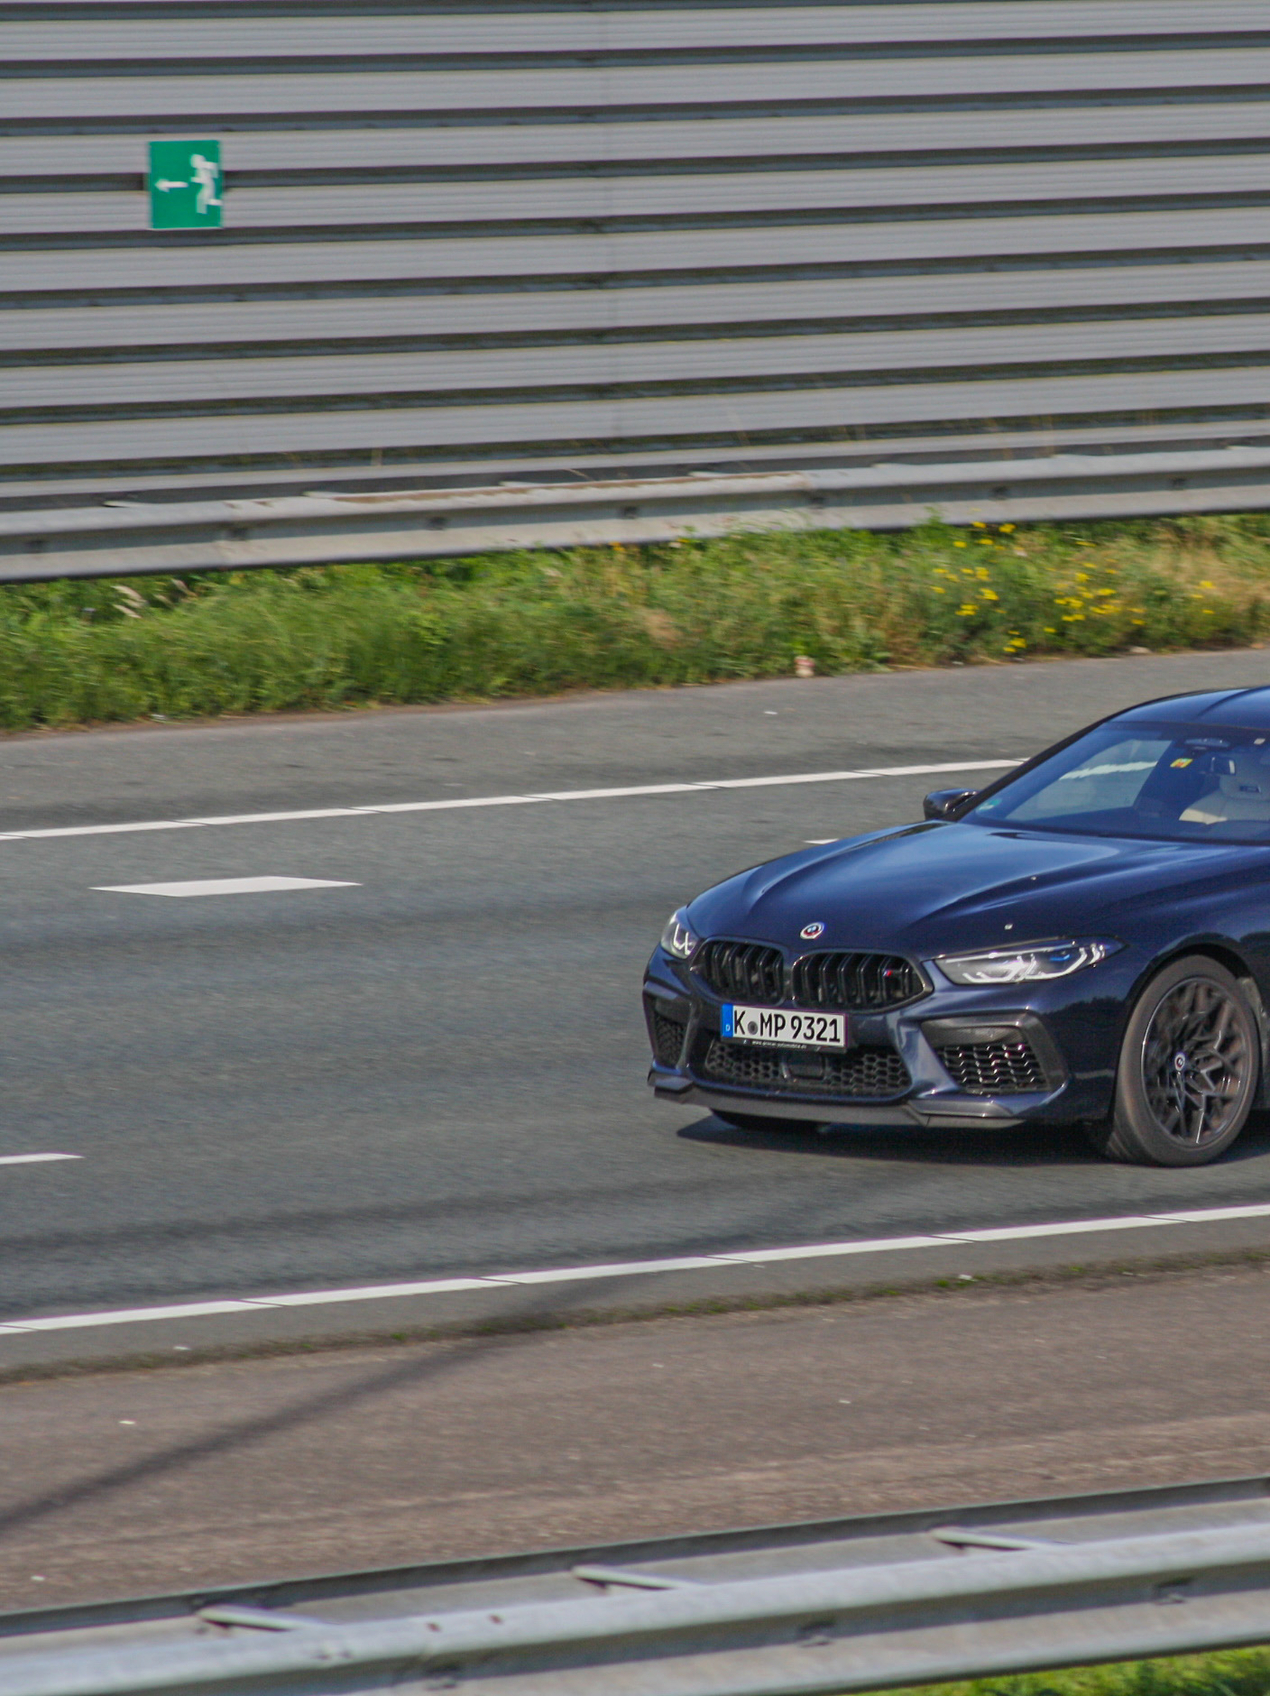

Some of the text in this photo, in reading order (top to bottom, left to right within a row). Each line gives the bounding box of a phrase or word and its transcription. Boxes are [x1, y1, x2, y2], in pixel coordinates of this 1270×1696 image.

[725, 1024, 731, 1032] D
[734, 1010, 841, 1043] K MP 9321
